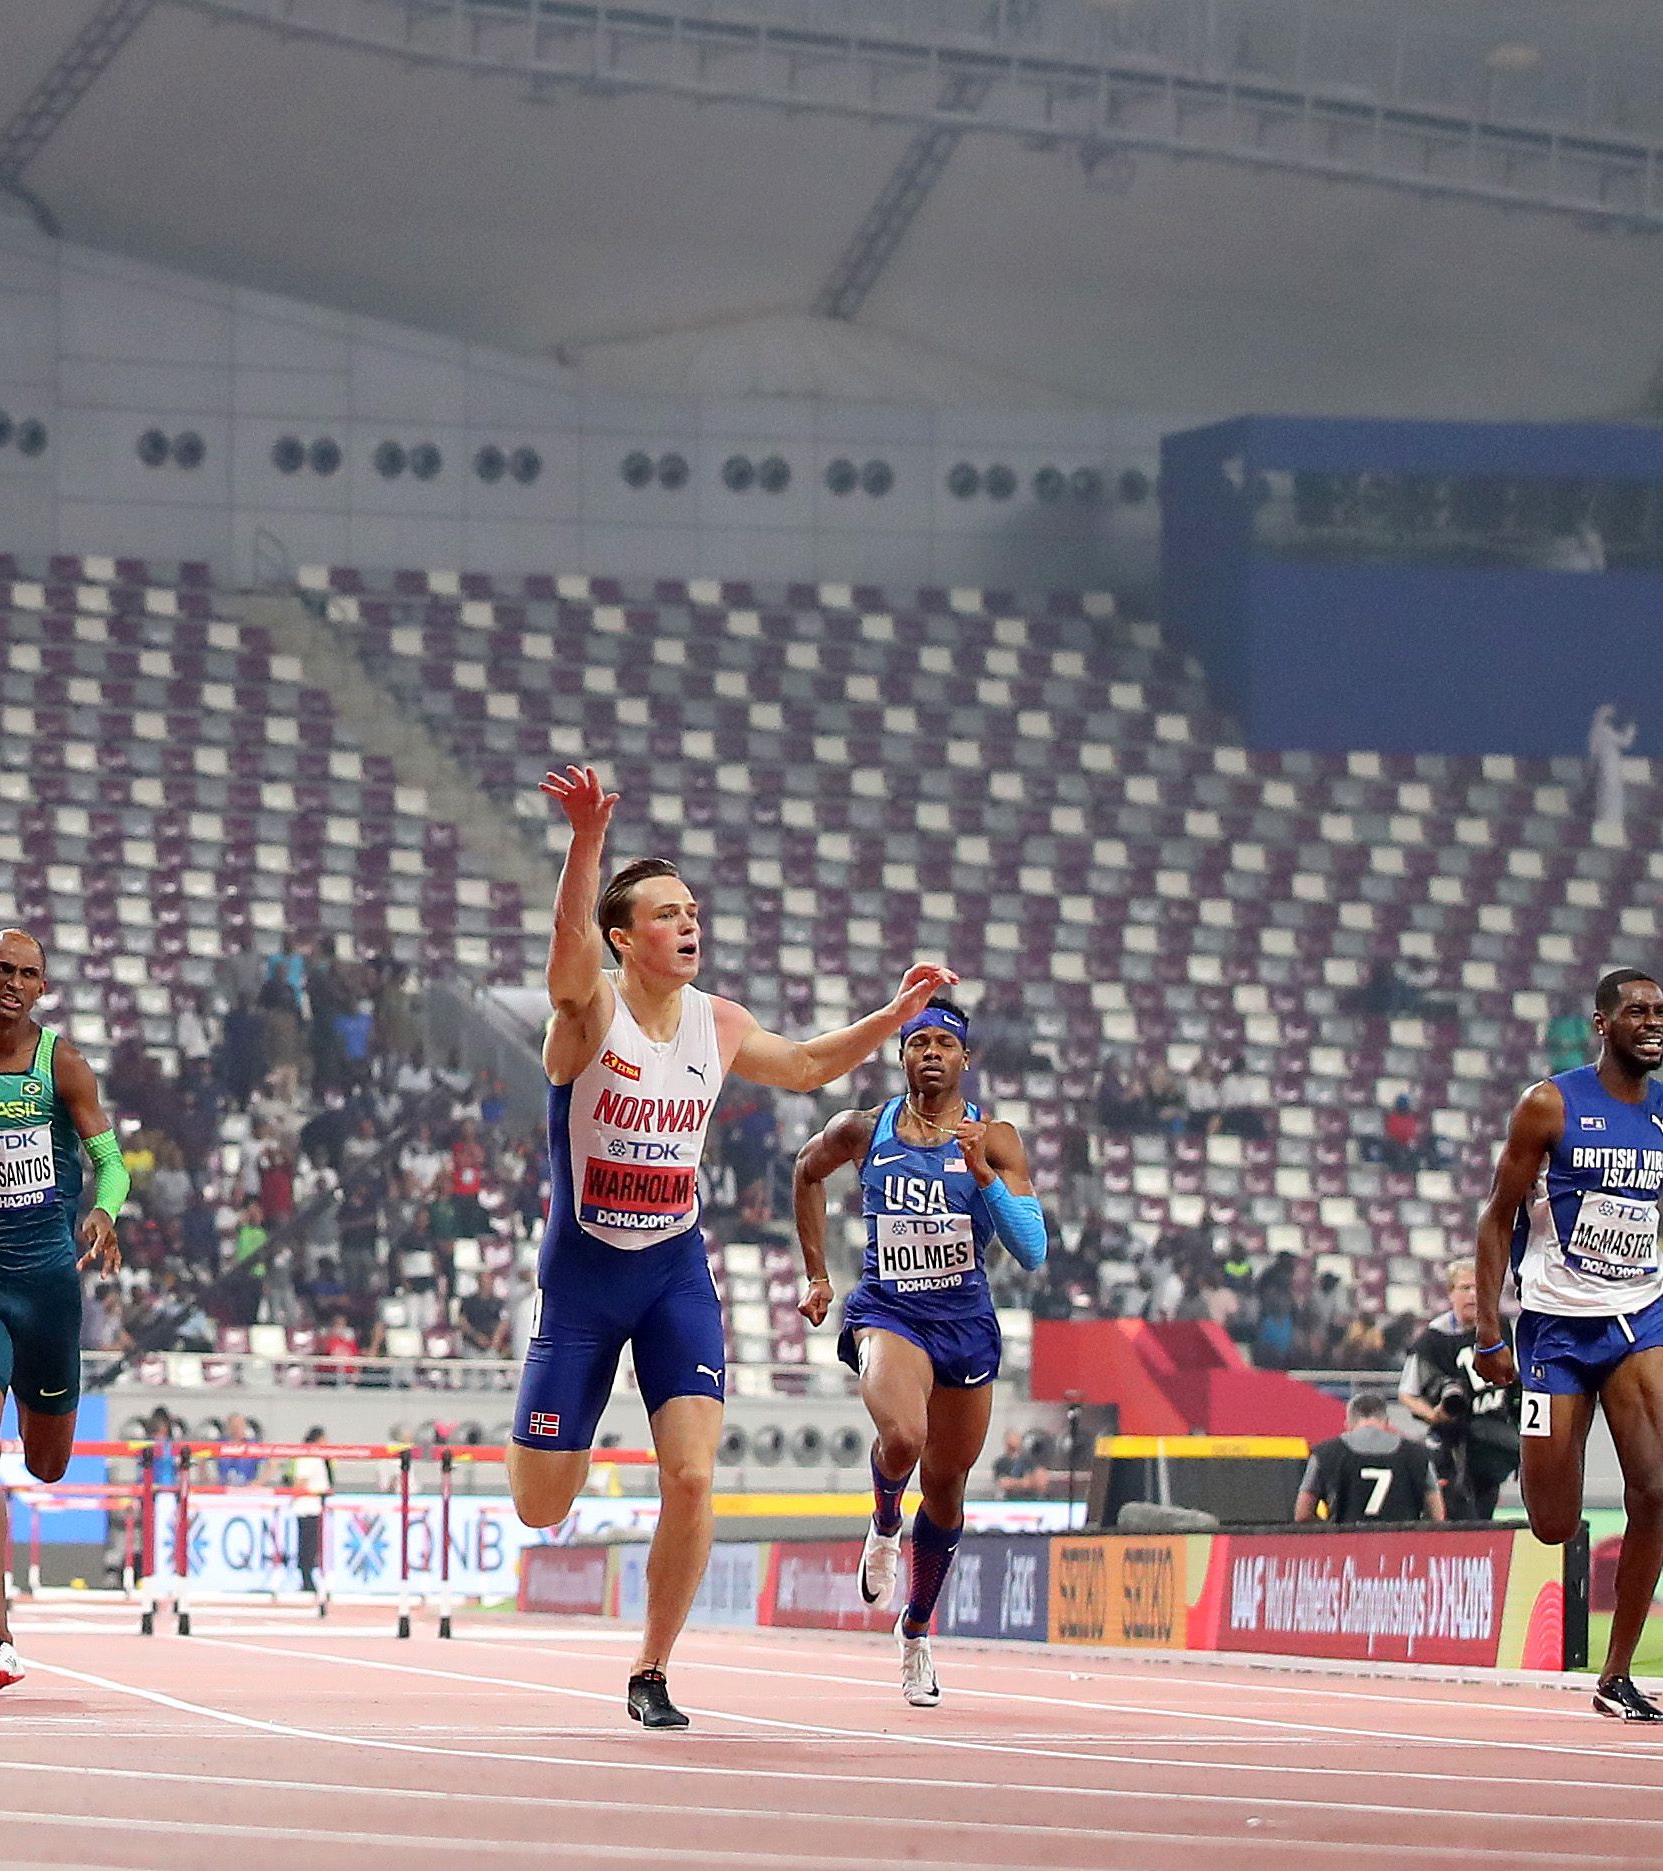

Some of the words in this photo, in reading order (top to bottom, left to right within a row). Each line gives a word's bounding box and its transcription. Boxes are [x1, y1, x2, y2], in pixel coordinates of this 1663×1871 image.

[593, 1088, 712, 1133] NORWAY
[626, 1141, 681, 1160] TDK
[1572, 1147, 1637, 1169] BRITISH
[588, 1165, 690, 1204] WARHOLM
[1601, 1168, 1662, 1190] ISLANDS
[884, 1175, 949, 1214] USA
[596, 1209, 675, 1229] DOHA2019
[1616, 1203, 1652, 1222] TDK
[906, 1218, 958, 1235] TDK
[1574, 1222, 1655, 1260] McMASTER
[883, 1241, 969, 1272] HOLMES
[897, 1273, 963, 1293] DOHA2019
[1527, 1399, 1540, 1429] 2
[1360, 1468, 1394, 1516] 7
